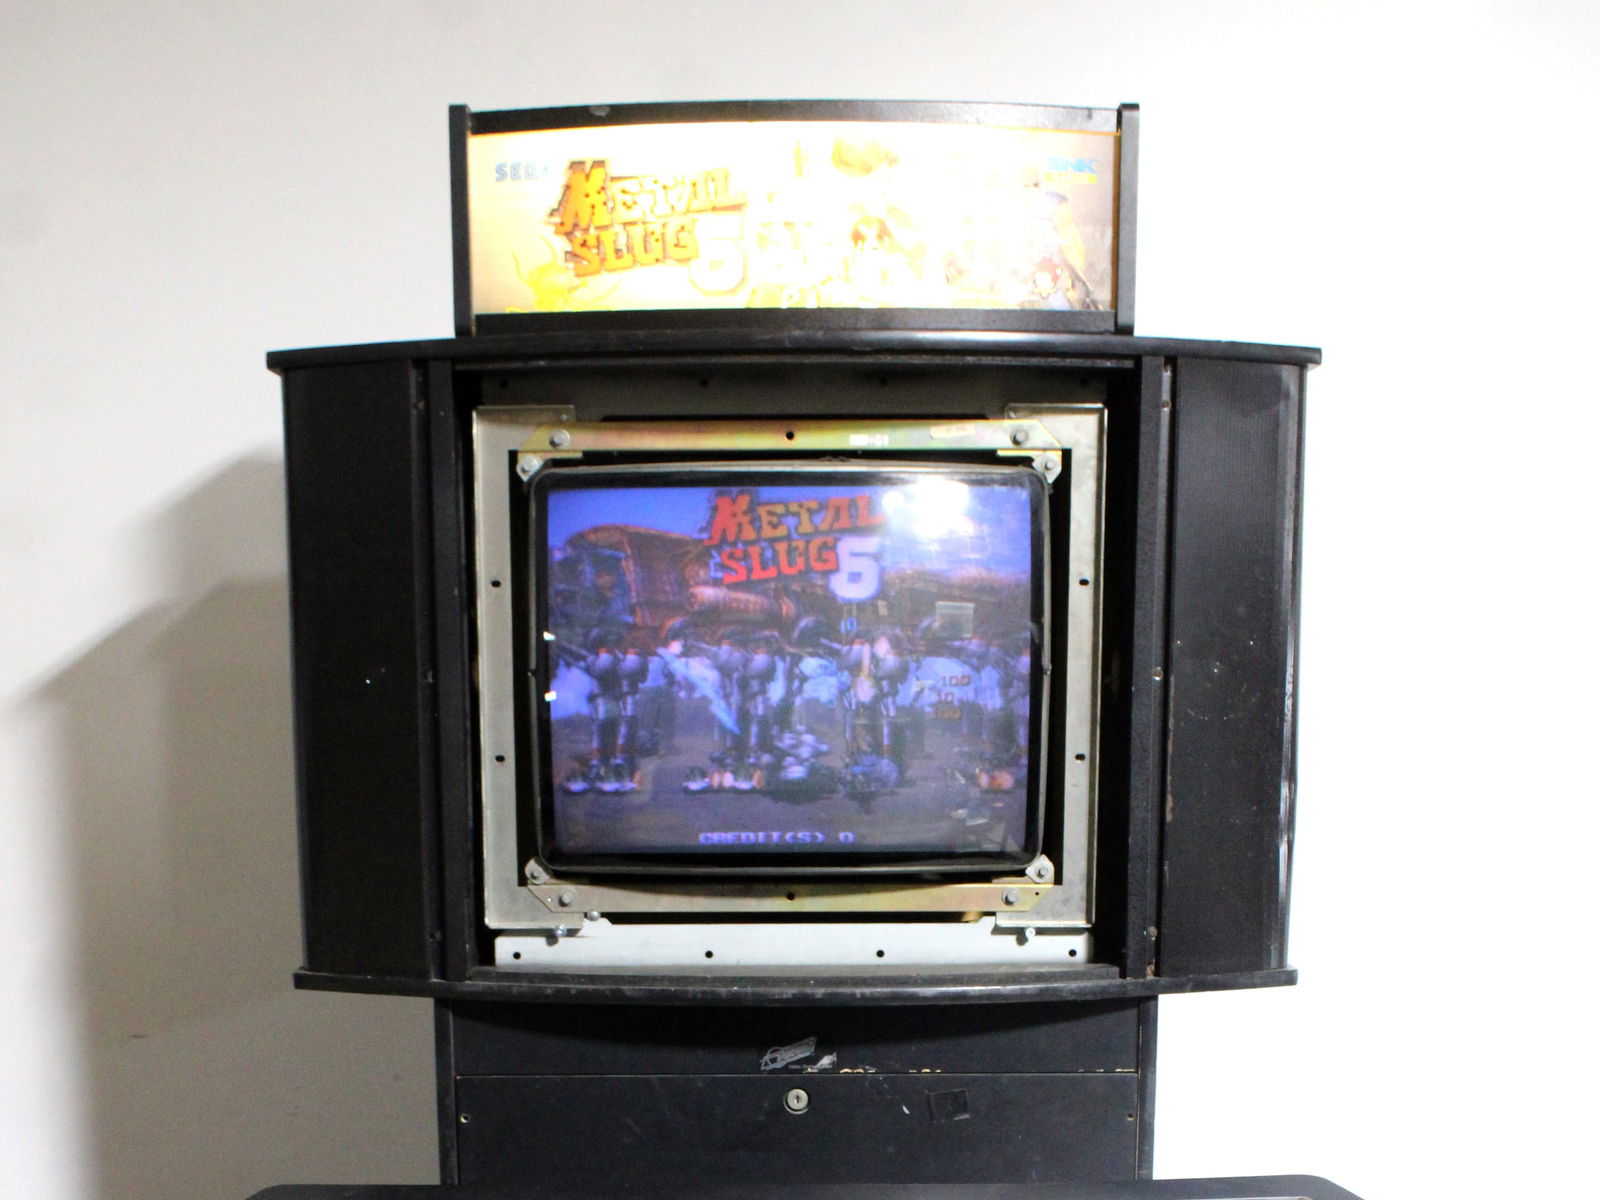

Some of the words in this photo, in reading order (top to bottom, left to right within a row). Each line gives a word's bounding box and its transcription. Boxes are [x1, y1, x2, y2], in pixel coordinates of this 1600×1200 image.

[495, 161, 552, 182] SEGA
[547, 158, 749, 236] METAL
[563, 215, 701, 279] SLUG
[703, 493, 887, 546] METAL
[719, 536, 840, 585] SLUG
[828, 534, 882, 600] 6
[699, 831, 826, 845] CREDIT(S)
